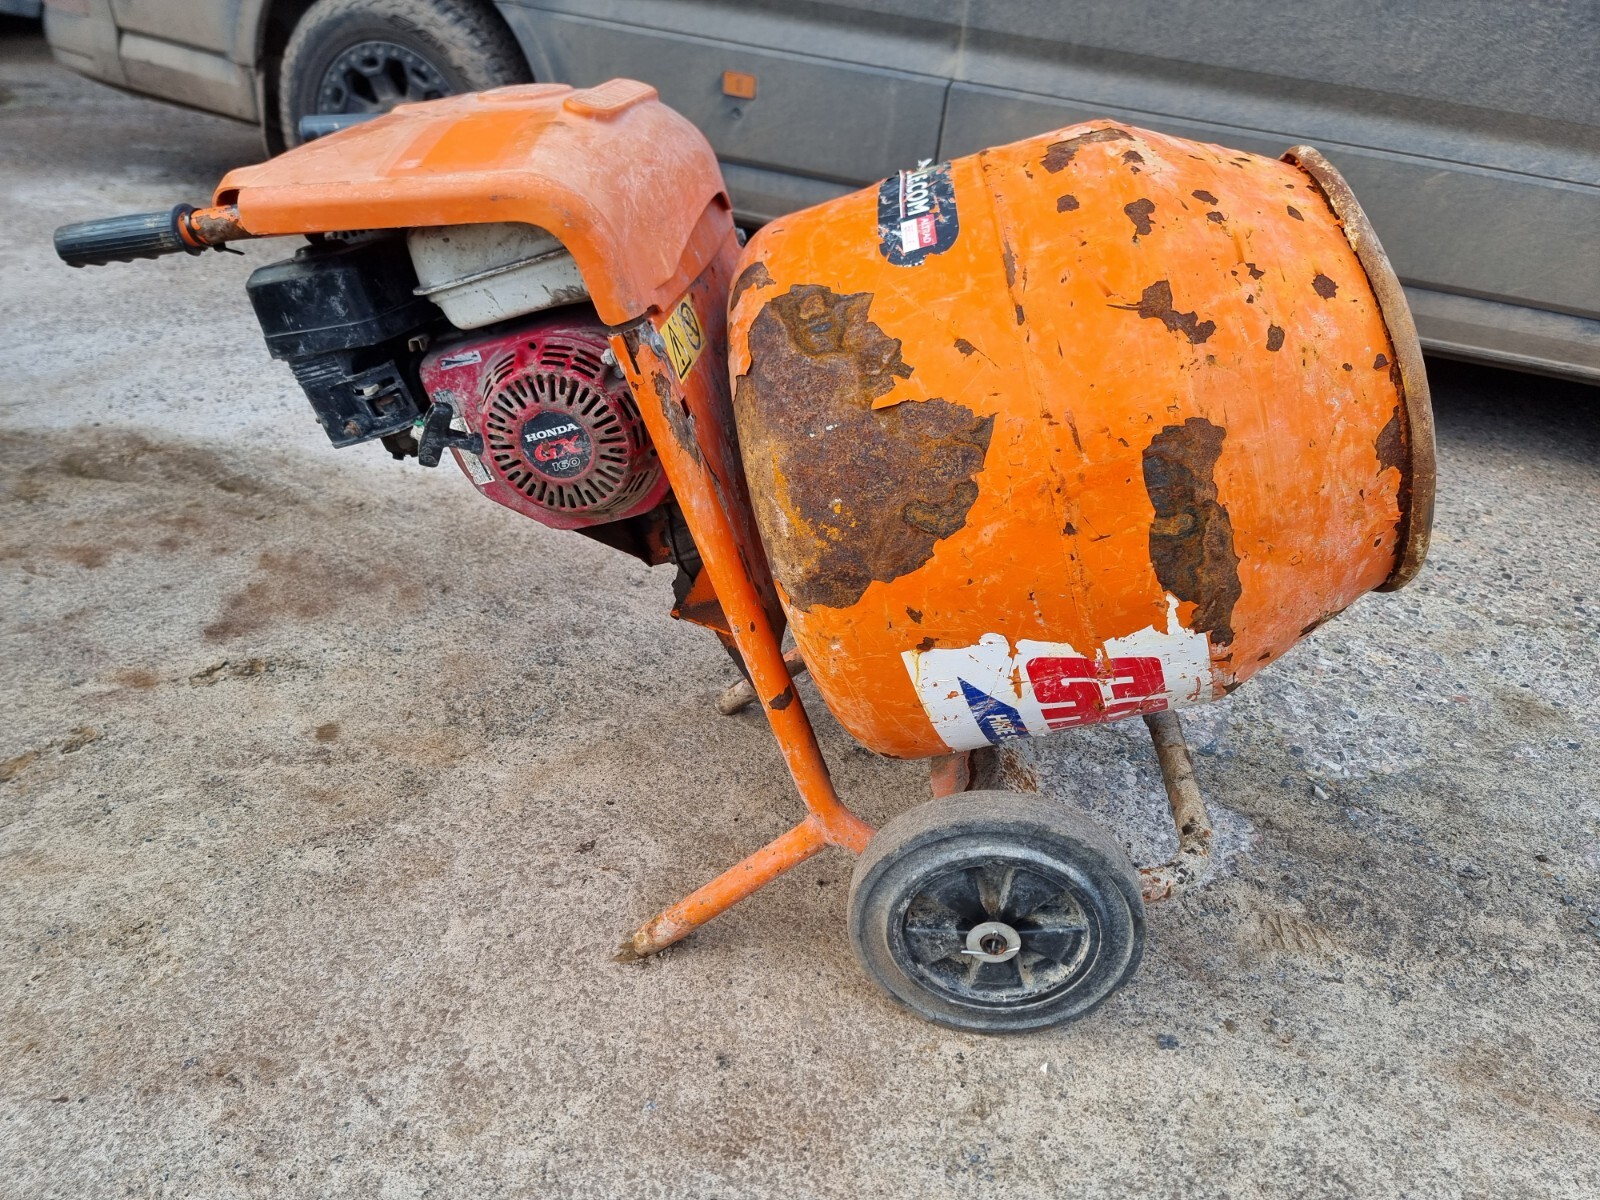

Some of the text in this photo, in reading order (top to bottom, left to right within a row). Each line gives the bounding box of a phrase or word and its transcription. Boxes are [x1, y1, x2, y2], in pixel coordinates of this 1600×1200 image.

[525, 423, 580, 443] HONDA
[534, 434, 583, 462] GX
[552, 457, 581, 472] 160
